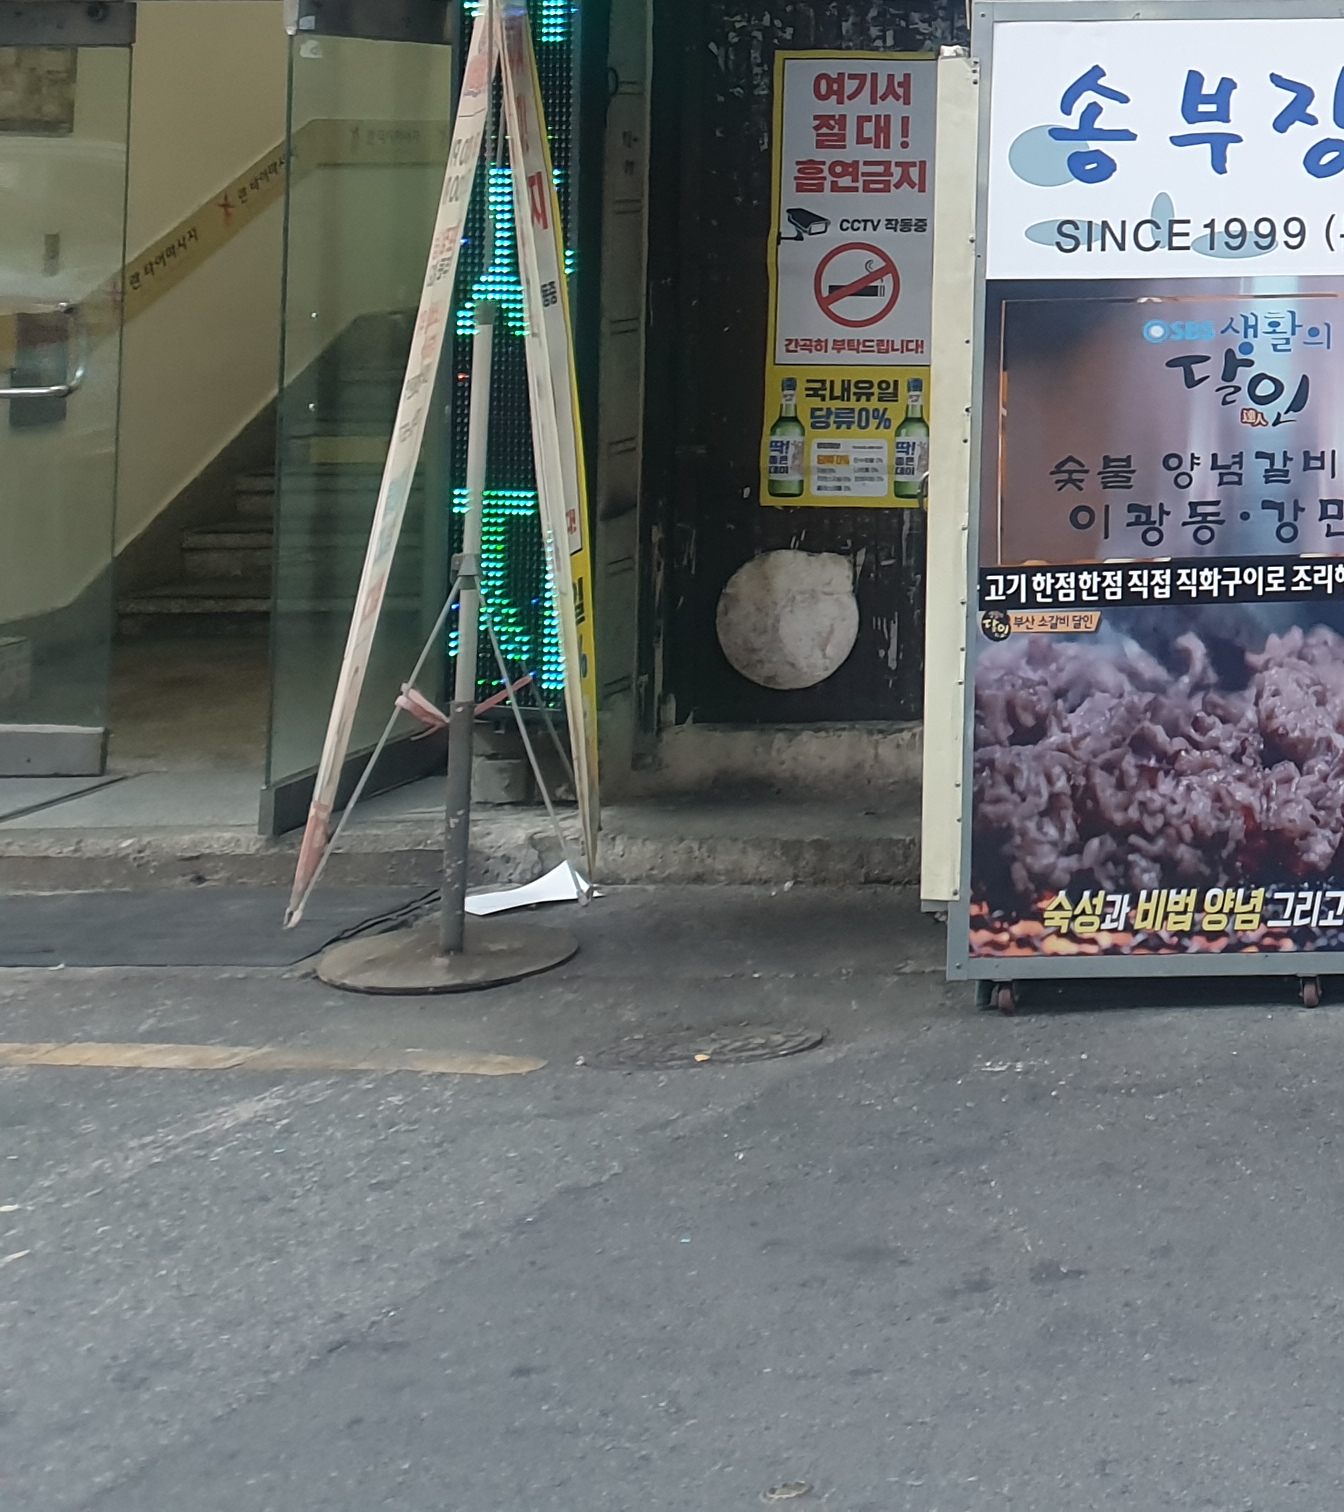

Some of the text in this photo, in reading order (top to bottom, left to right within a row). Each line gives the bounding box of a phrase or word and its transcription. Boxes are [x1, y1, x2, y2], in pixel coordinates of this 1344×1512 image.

[812, 72, 912, 106] 여기서
[794, 159, 927, 194] 흡연금지
[839, 218, 927, 232] CCTV 작동중
[784, 338, 924, 354] 간곡히 부탁드립니다!
[1220, 310, 1331, 356] 생활의
[805, 379, 899, 402] 국내유일
[1165, 348, 1309, 427] 달인
[810, 407, 892, 430] 당류0%
[1162, 448, 1336, 489] 양념갈비
[985, 574, 1026, 603] 고기
[1128, 568, 1171, 599] 직접
[1176, 566, 1286, 598] 직화구이로
[1014, 615, 1035, 630] 부산
[1038, 615, 1069, 629] 소갈비
[1072, 615, 1093, 629] 달인
[1043, 889, 1130, 932] 숙성과
[1134, 888, 1198, 931] 비법
[1203, 887, 1264, 931] 양념
